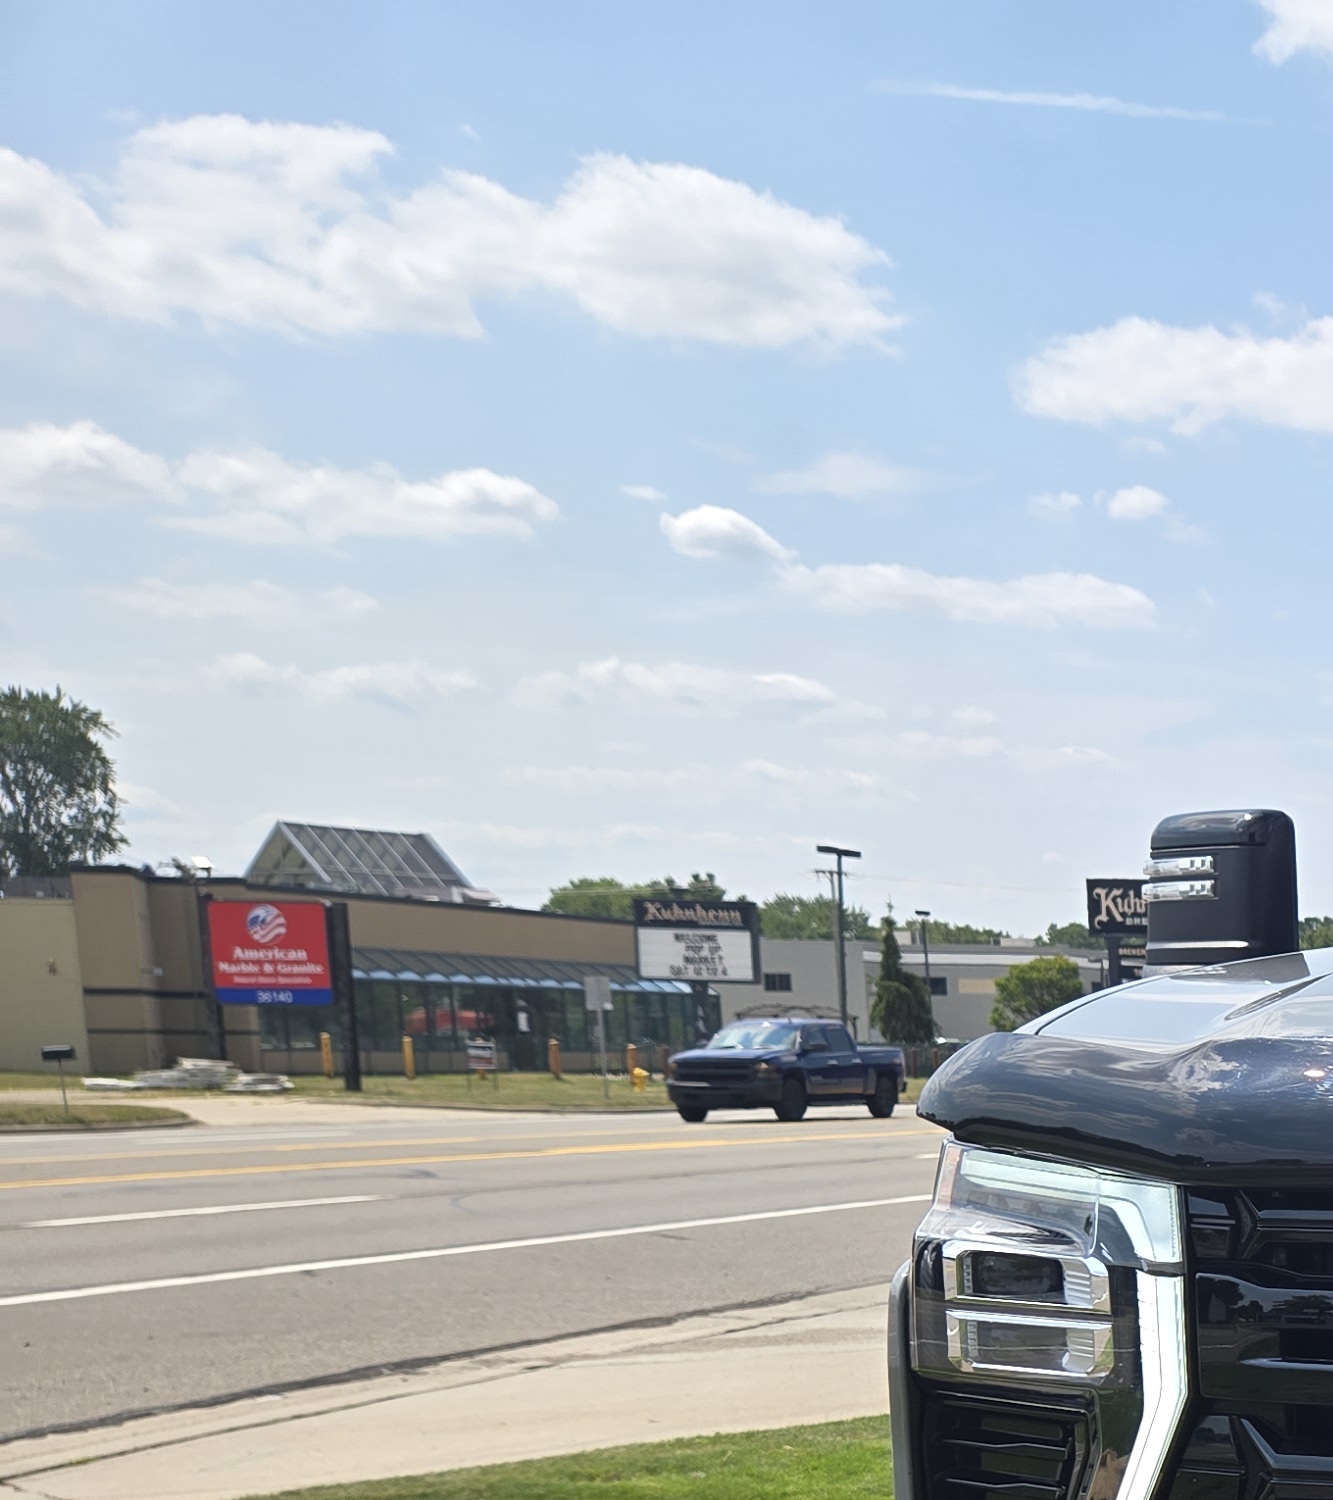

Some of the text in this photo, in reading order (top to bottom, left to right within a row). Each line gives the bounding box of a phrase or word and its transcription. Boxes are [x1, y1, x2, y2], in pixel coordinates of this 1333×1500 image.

[232, 946, 308, 961] American
[218, 961, 325, 974] Marble & Granite
